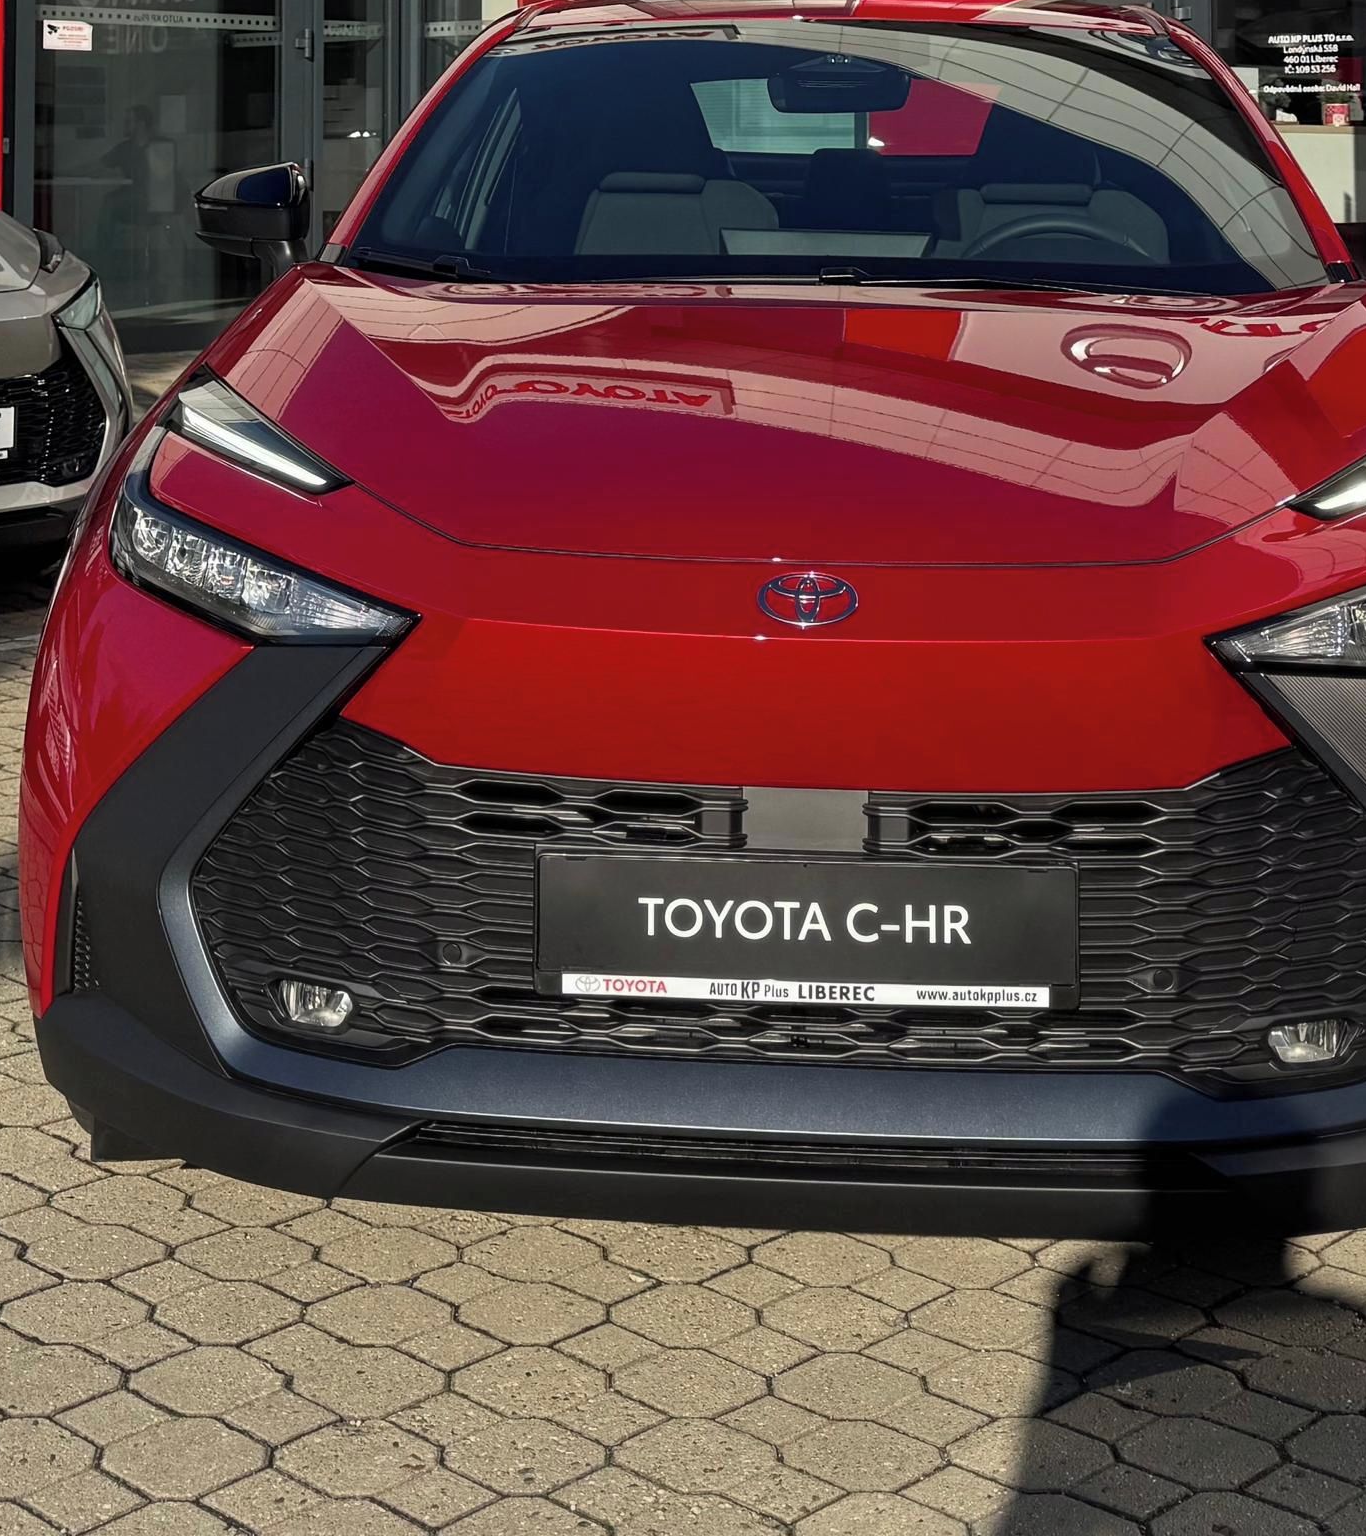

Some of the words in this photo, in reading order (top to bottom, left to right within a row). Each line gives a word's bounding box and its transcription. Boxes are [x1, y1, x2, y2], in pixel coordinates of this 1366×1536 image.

[638, 897, 831, 943] TOYOTA
[846, 903, 971, 945] C-HR
[602, 978, 667, 995] TOYOTA
[709, 982, 738, 997] AUTO
[740, 981, 760, 1000] KP
[764, 985, 789, 999] Plus
[798, 985, 875, 1002] LIBEREC
[916, 989, 1038, 1005] www.autokpplus.cz
